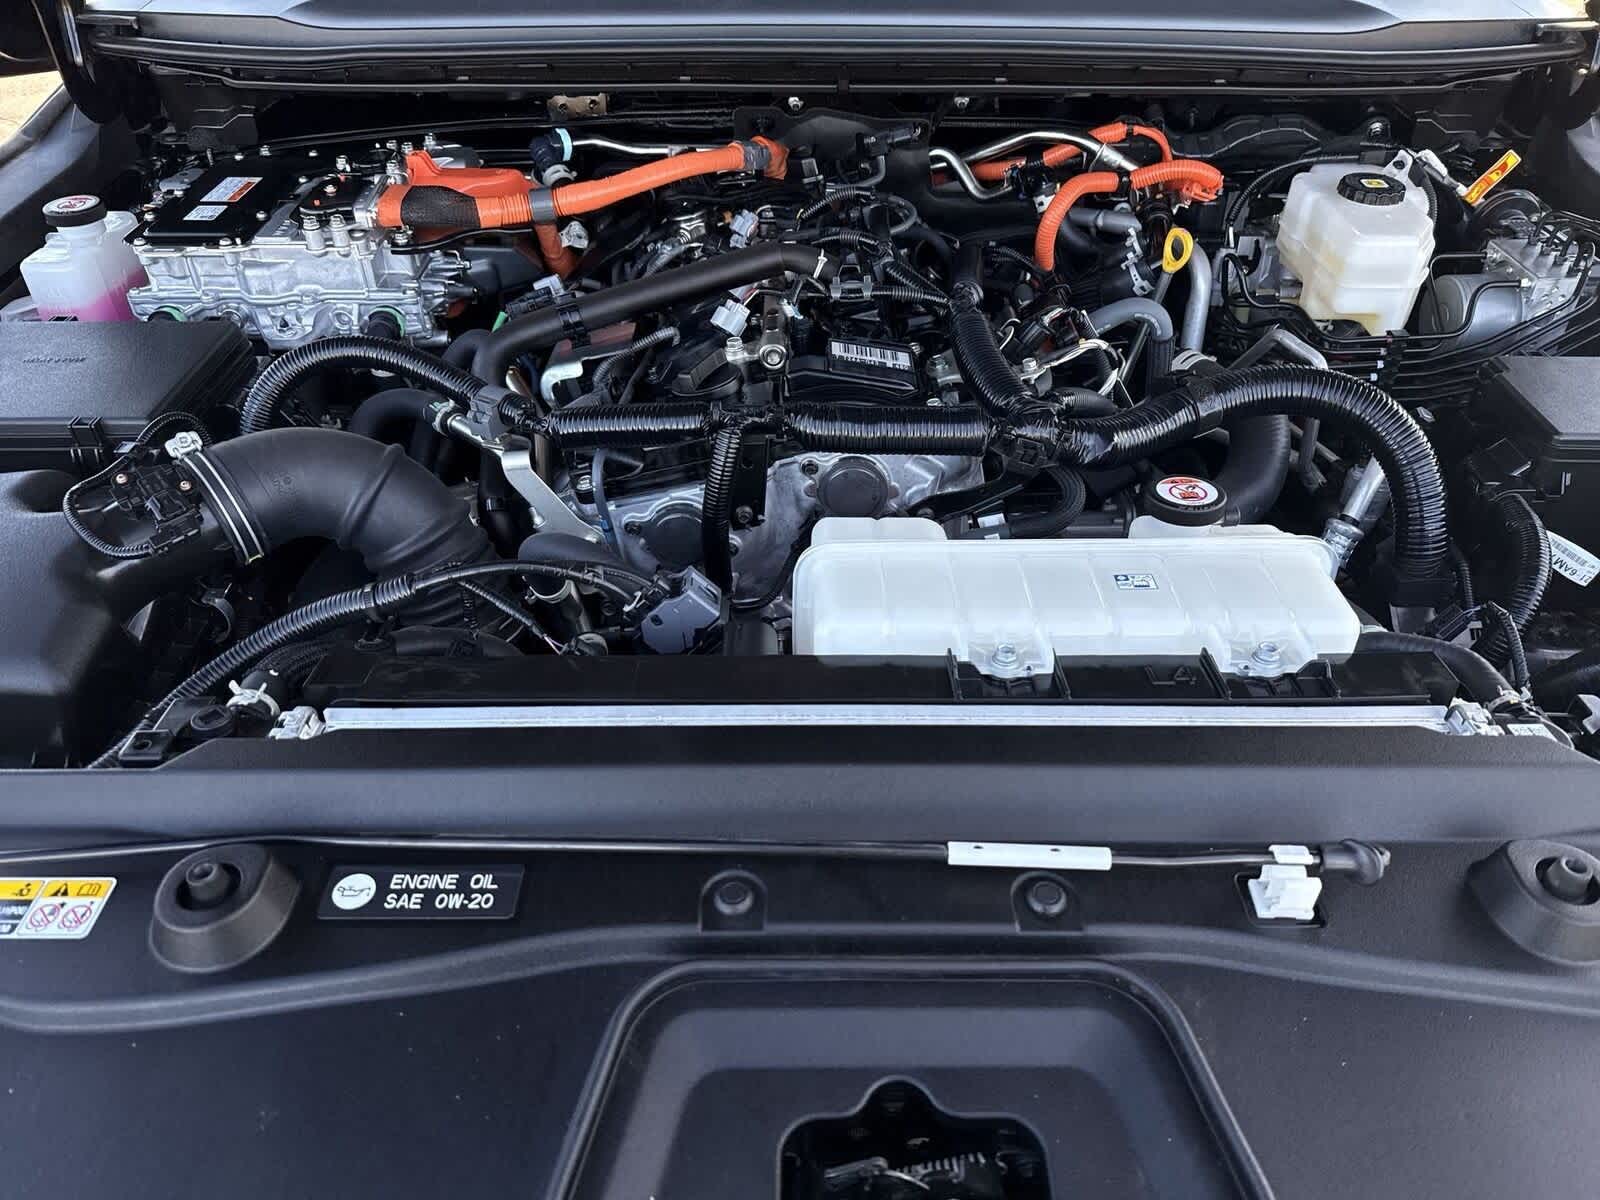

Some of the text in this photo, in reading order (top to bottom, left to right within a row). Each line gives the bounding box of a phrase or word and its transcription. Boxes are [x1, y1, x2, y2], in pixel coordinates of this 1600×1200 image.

[390, 874, 498, 889] ENGINE OIL
[384, 893, 494, 909] SAE 0W-20
